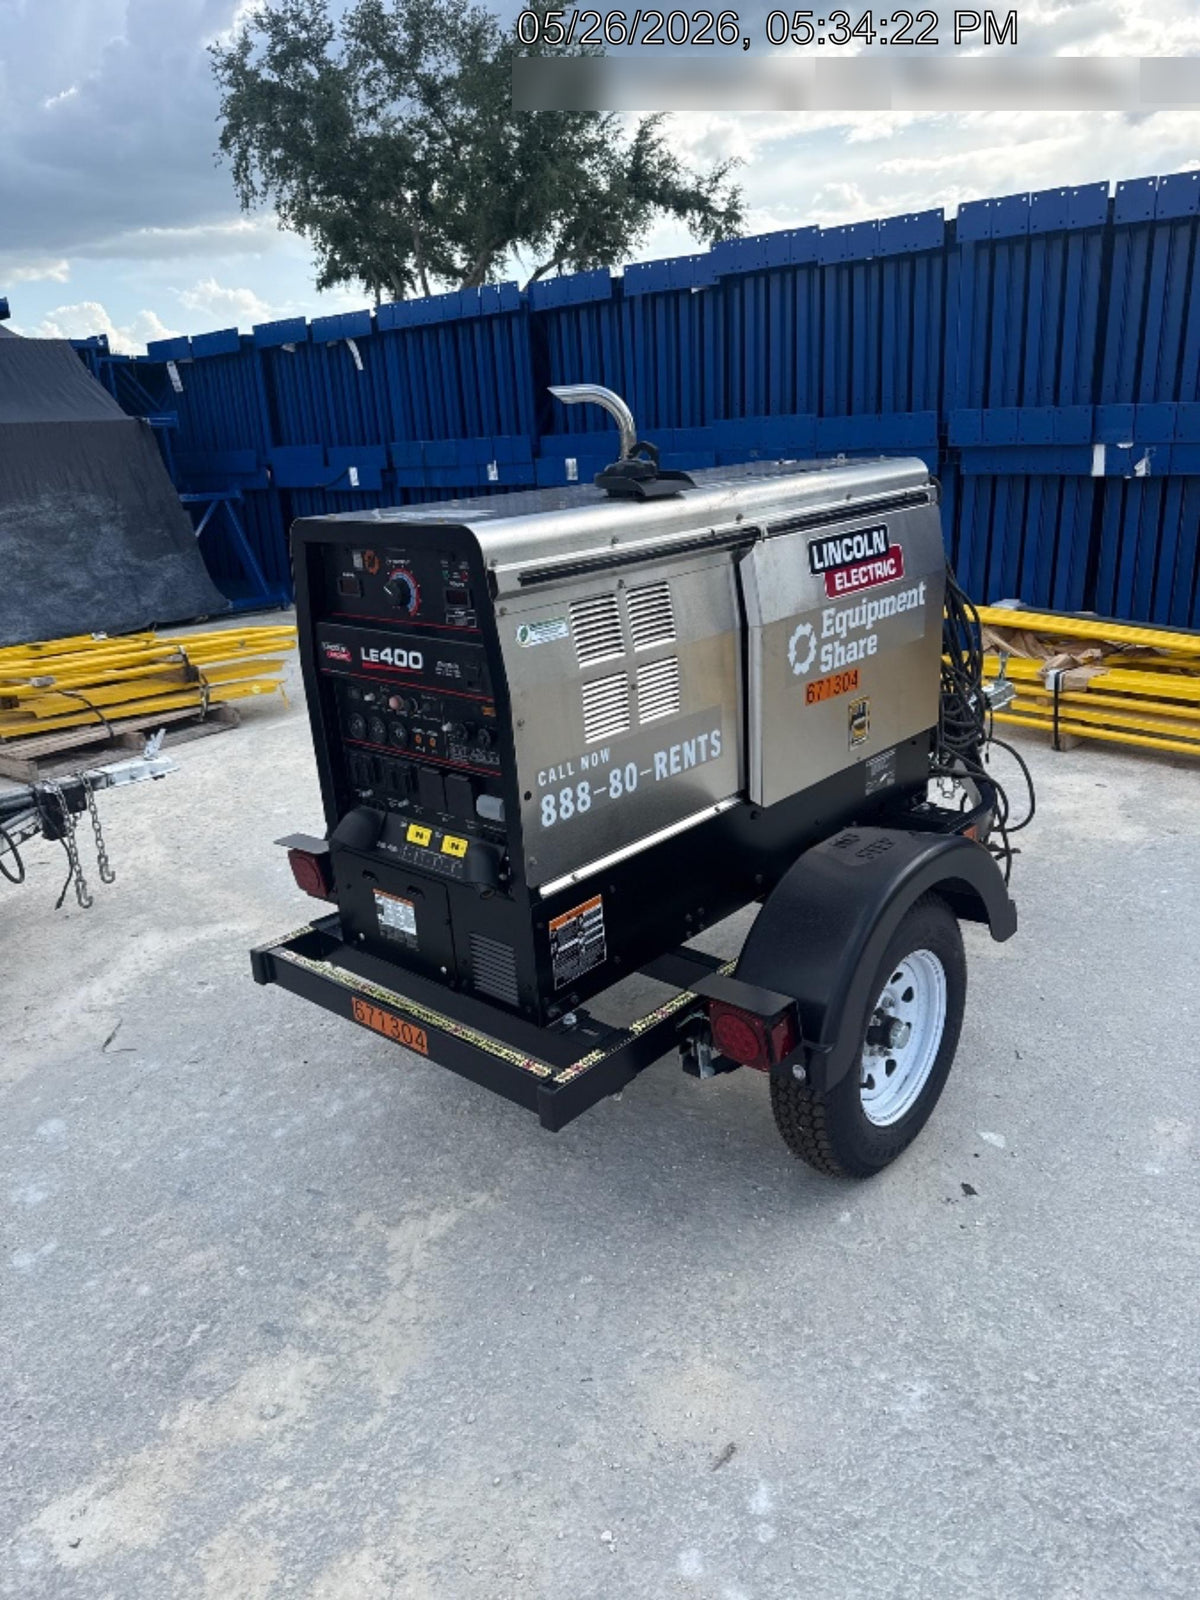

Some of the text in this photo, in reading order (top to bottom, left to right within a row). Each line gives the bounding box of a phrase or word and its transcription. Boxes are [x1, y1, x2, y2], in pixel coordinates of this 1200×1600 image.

[811, 529, 887, 569] LINCOLN
[834, 557, 897, 591] ELECTRIC
[820, 581, 927, 639] Equipment
[360, 647, 424, 670] LE400
[819, 634, 878, 673] Share
[806, 669, 859, 704] 671304
[538, 747, 611, 786] CALL NOW
[540, 729, 722, 827] 888-80-RENTS
[354, 1000, 426, 1052] 671304
